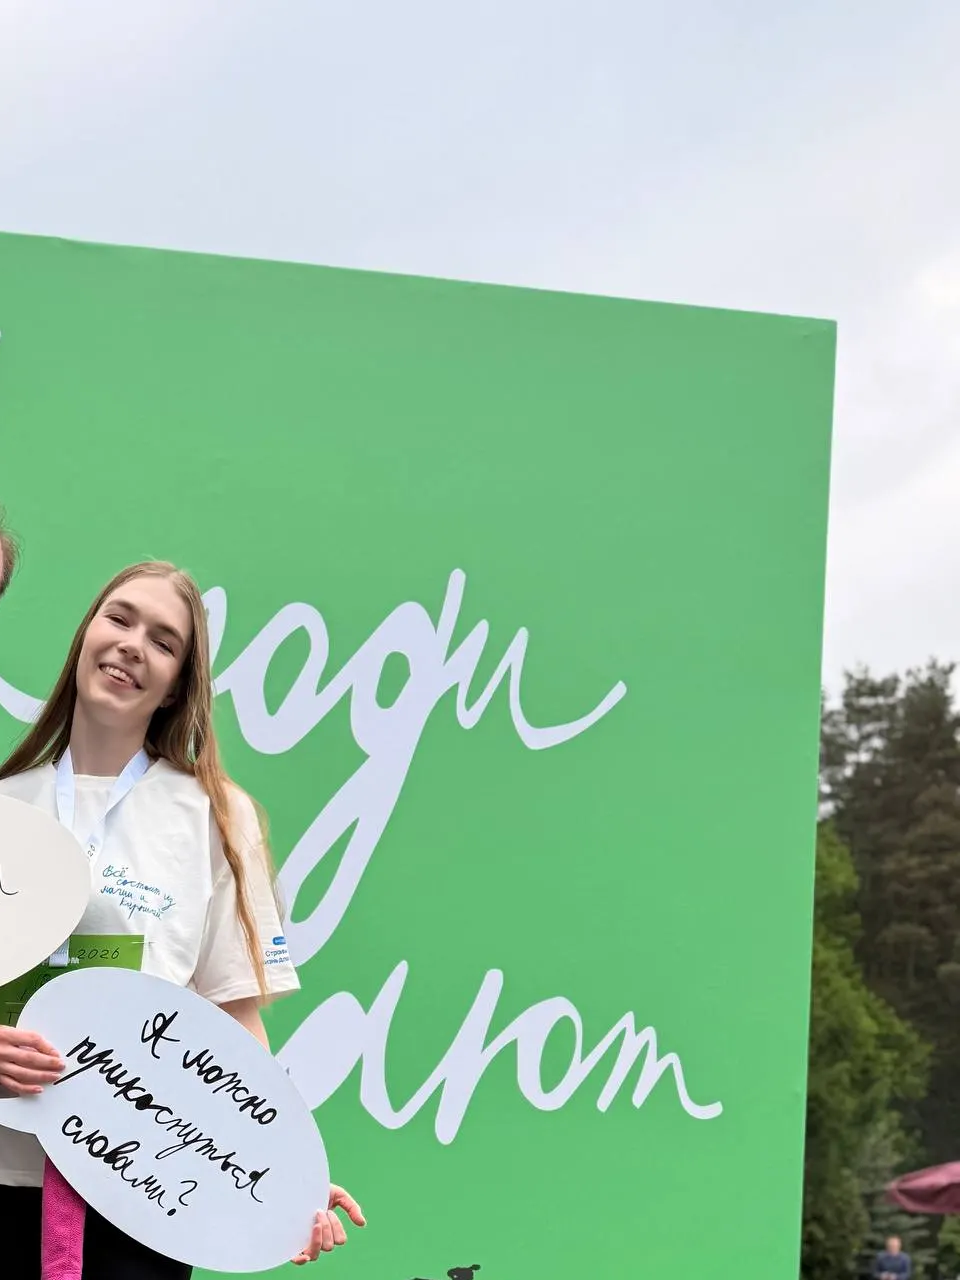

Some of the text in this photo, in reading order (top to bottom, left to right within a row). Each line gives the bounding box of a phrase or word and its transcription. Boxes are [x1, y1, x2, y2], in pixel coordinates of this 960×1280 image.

[102, 864, 129, 878] Всё
[77, 946, 120, 960] 2026
[182, 1048, 278, 1126] можно
